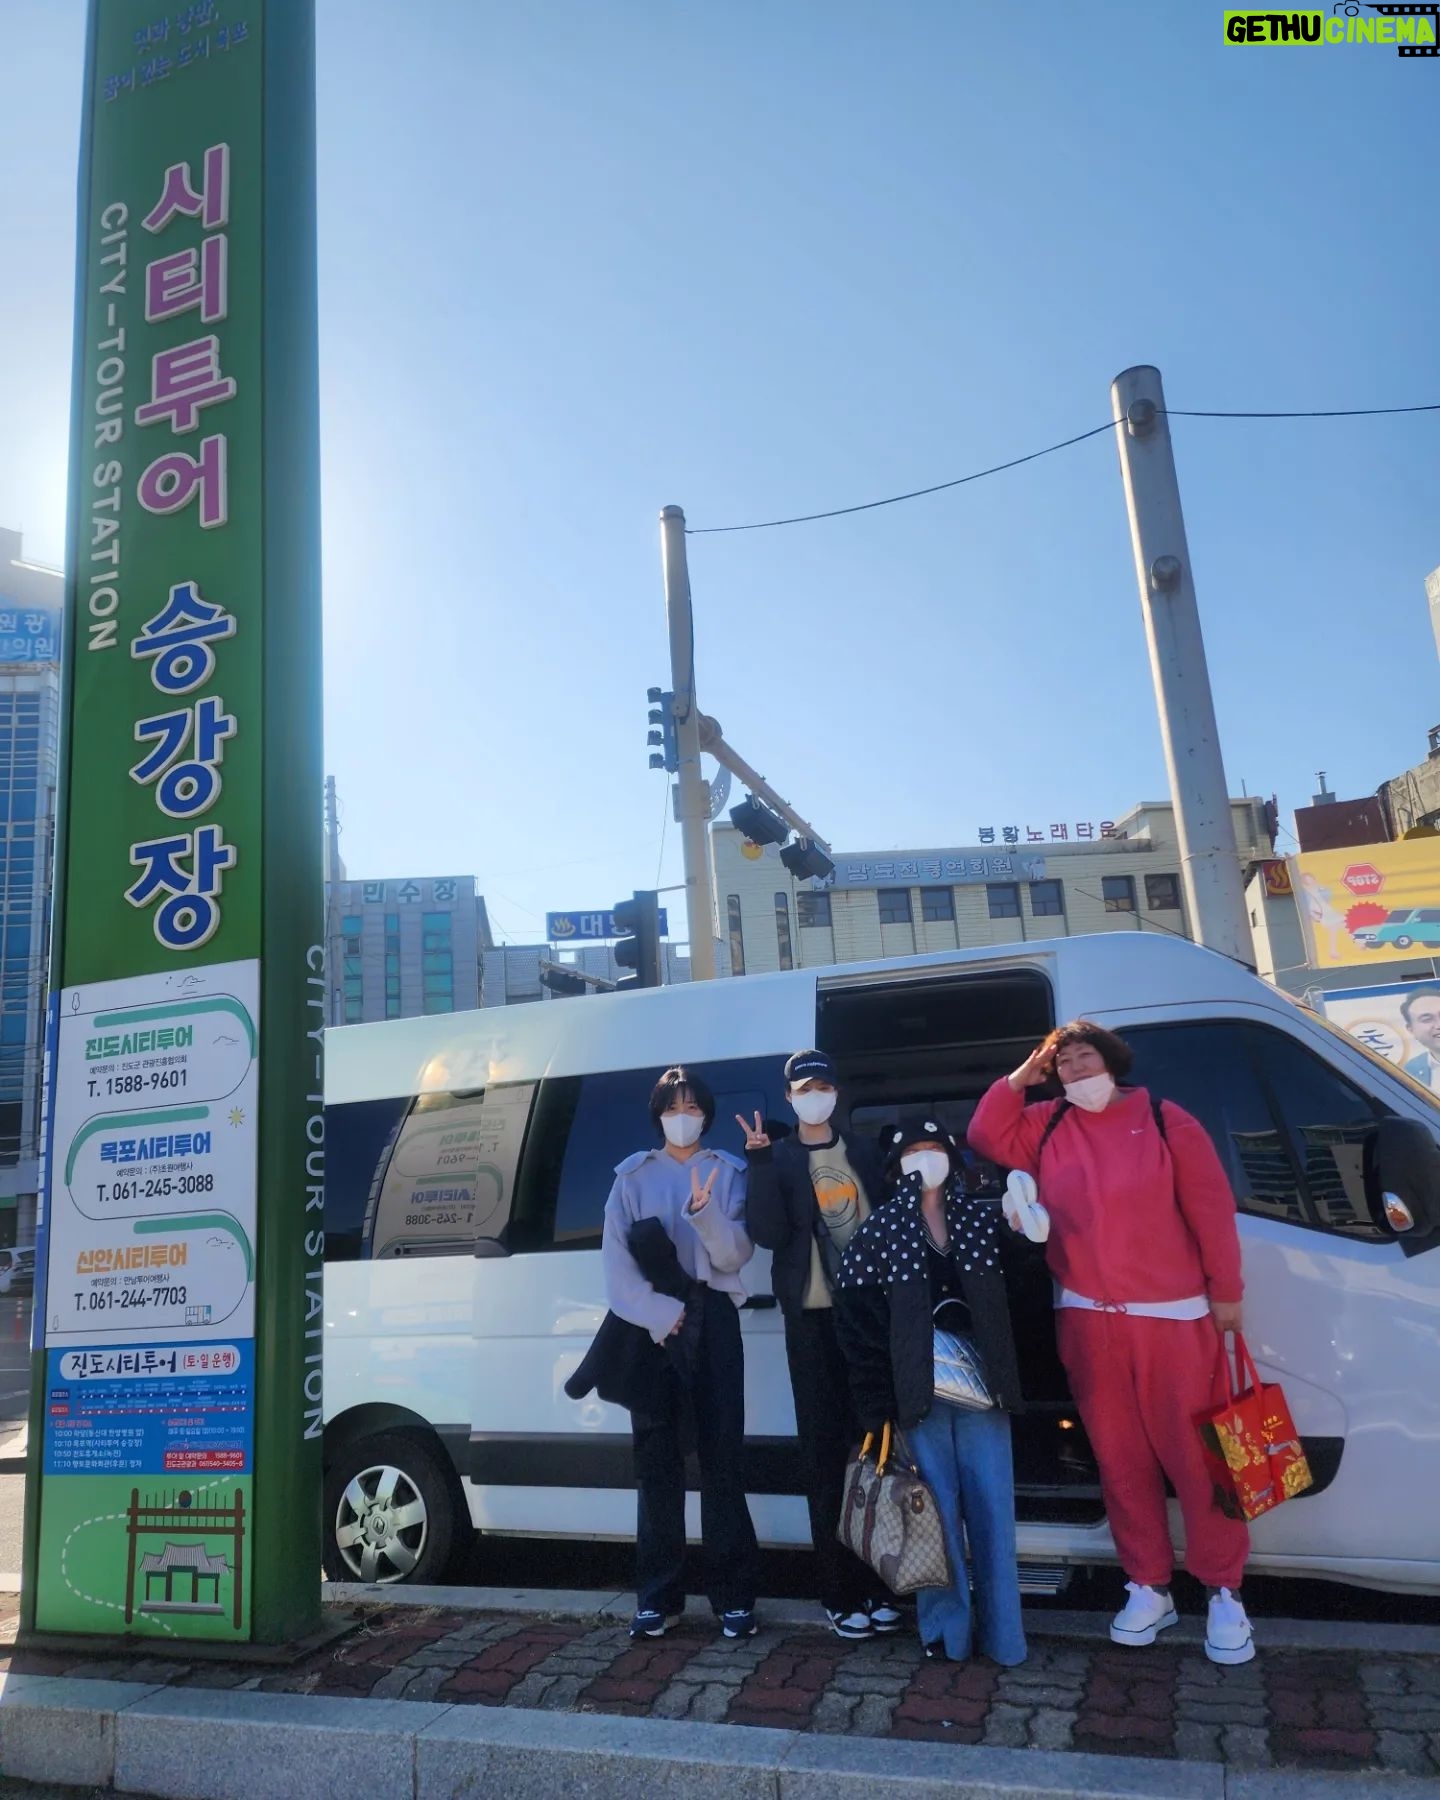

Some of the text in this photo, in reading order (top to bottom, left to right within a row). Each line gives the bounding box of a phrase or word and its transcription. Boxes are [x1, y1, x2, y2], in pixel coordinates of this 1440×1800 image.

[88, 202, 128, 651] CITY-TOUR STATION
[124, 142, 236, 951] 시티투어 승강장
[847, 856, 1013, 882] 남도전통연희원
[85, 1024, 193, 1061] 진도시티투어
[106, 1069, 187, 1095] 1588-9601
[100, 1131, 211, 1163] 목포시티투어
[76, 1242, 188, 1274] 신안시티투어
[71, 1351, 177, 1378] 진도시티투어
